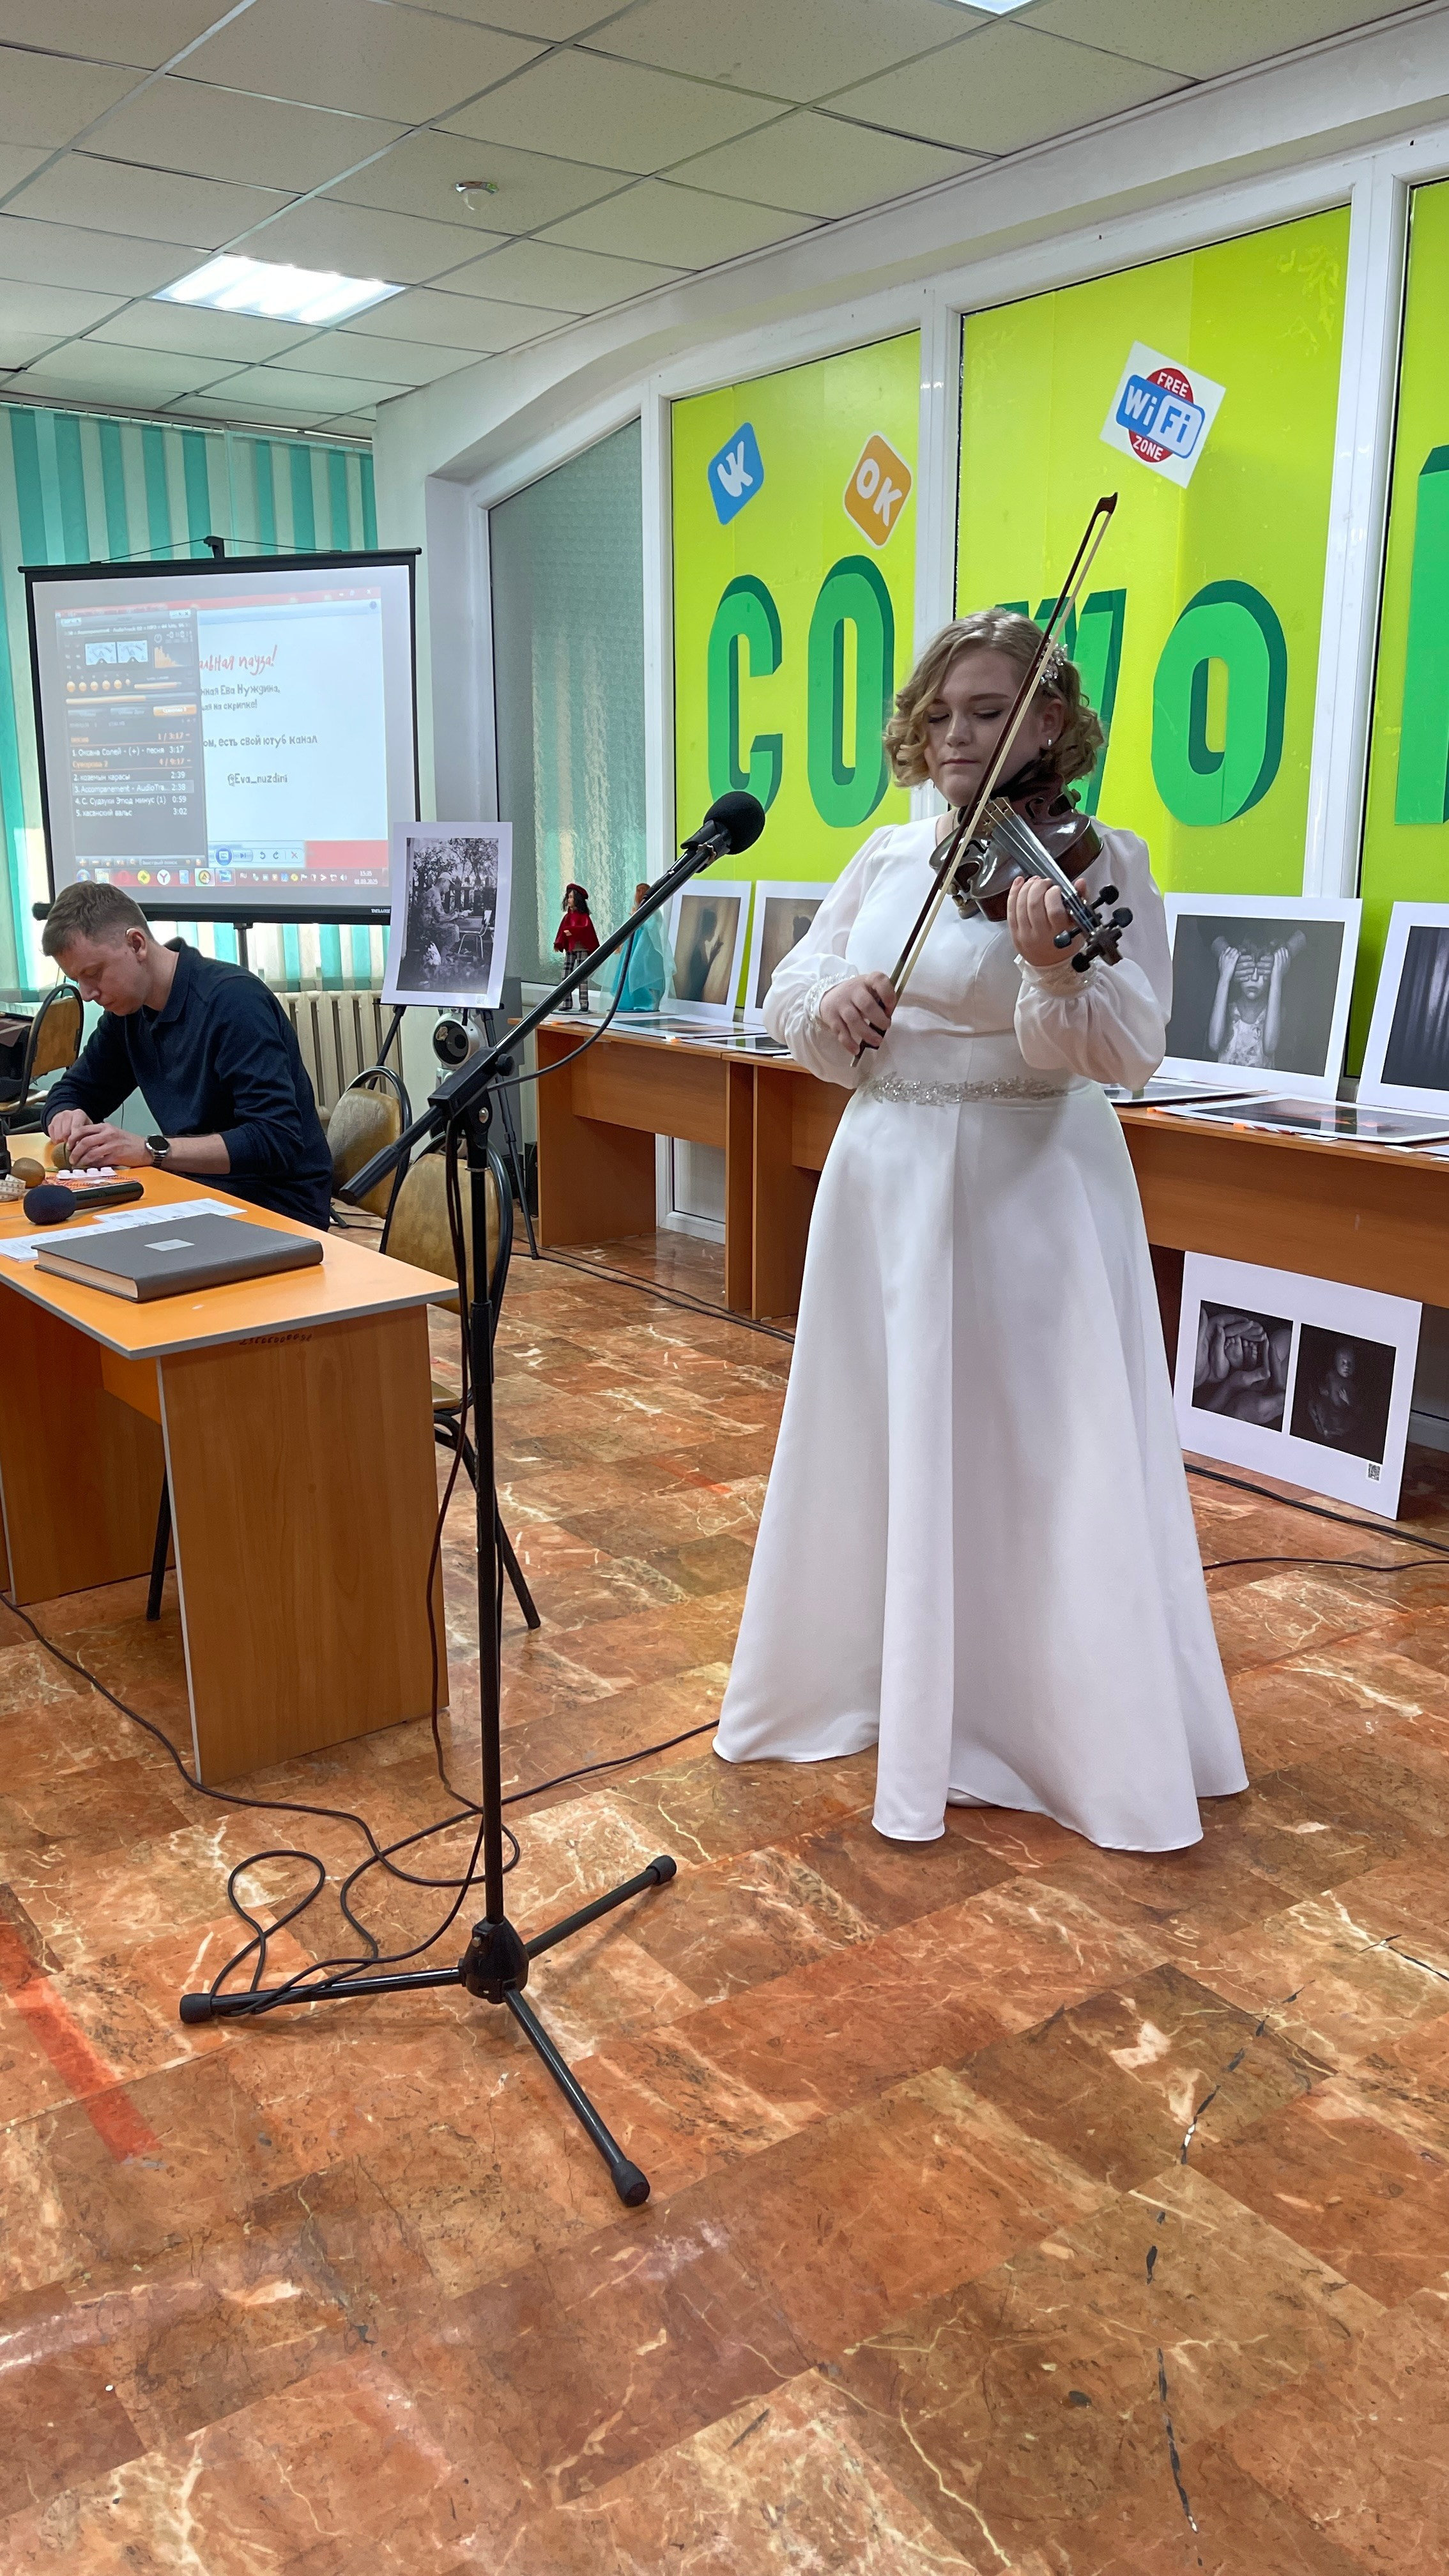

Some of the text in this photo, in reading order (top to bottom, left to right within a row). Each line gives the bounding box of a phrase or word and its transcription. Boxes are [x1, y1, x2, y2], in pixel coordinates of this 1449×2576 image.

[1156, 371, 1189, 398] FREE
[1132, 435, 1164, 461] ZONE
[857, 458, 903, 527] OK
[238, 644, 278, 676] пауза!
[220, 684, 236, 696] Ева
[223, 699, 258, 712] скрипке!
[218, 739, 238, 747] есть
[240, 735, 262, 746] свой
[288, 735, 318, 745] канал
[169, 746, 185, 754] 3:17
[172, 807, 188, 816] 3:02
